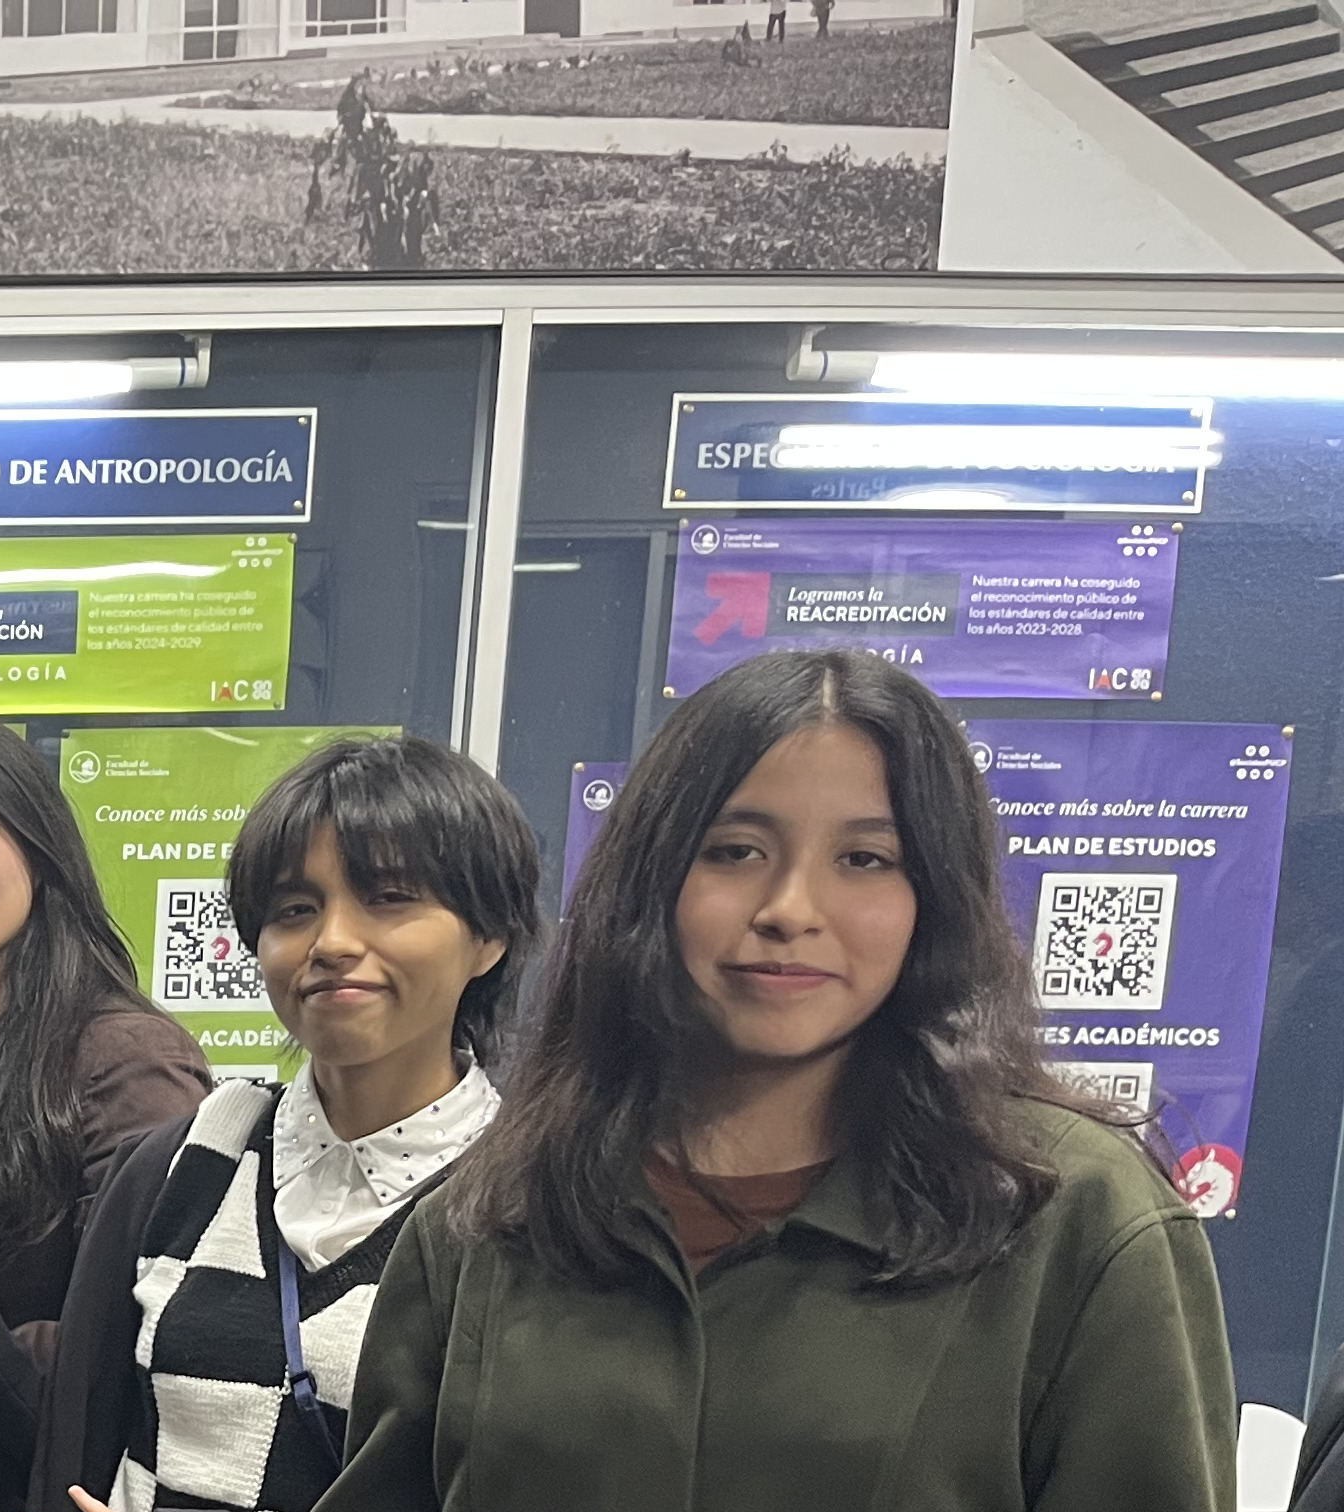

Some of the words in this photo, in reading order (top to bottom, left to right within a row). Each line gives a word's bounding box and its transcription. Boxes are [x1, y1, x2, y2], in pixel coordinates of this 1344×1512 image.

[10, 460, 47, 485] DE
[55, 450, 293, 485] ANTROPOLOGÍA
[973, 575, 1019, 587] Nuestra
[1021, 577, 1062, 587] carrera
[1064, 576, 1078, 588] ha
[1081, 577, 1140, 590] coseguido
[788, 587, 864, 604] Logramos
[868, 587, 883, 601] la
[971, 592, 982, 602] el
[984, 592, 1074, 604] reconocimiento
[1076, 592, 1119, 606] público
[1121, 593, 1137, 604] de
[88, 608, 99, 618] el
[101, 607, 191, 618] reconocimiento
[193, 606, 237, 620] público
[239, 606, 254, 616] de
[787, 602, 947, 622] REACREDITACIÓN
[969, 607, 986, 618] los
[988, 607, 1051, 619] estándares
[1053, 607, 1068, 619] de
[1070, 608, 1112, 620] calidad
[1113, 610, 1145, 620] entre
[88, 624, 104, 634] los
[106, 622, 170, 634] estándares
[171, 622, 186, 633] de
[188, 621, 230, 632] calidad
[232, 621, 263, 632] entre
[967, 623, 984, 634] los
[986, 623, 1013, 635] años
[96, 805, 164, 822] Conoce
[170, 804, 208, 821] más
[212, 804, 250, 821] sob
[1059, 799, 1097, 816] más
[1102, 799, 1154, 817] sobre
[1158, 799, 1175, 817] la
[1180, 804, 1248, 819] carrera
[122, 843, 181, 860] PLAN
[187, 843, 216, 860] DE
[1009, 836, 1069, 855] PLAN
[1074, 837, 1104, 856] DE
[1108, 838, 1216, 858] ESTUDIOS
[1074, 1023, 1221, 1046] ACADÉMICOS
